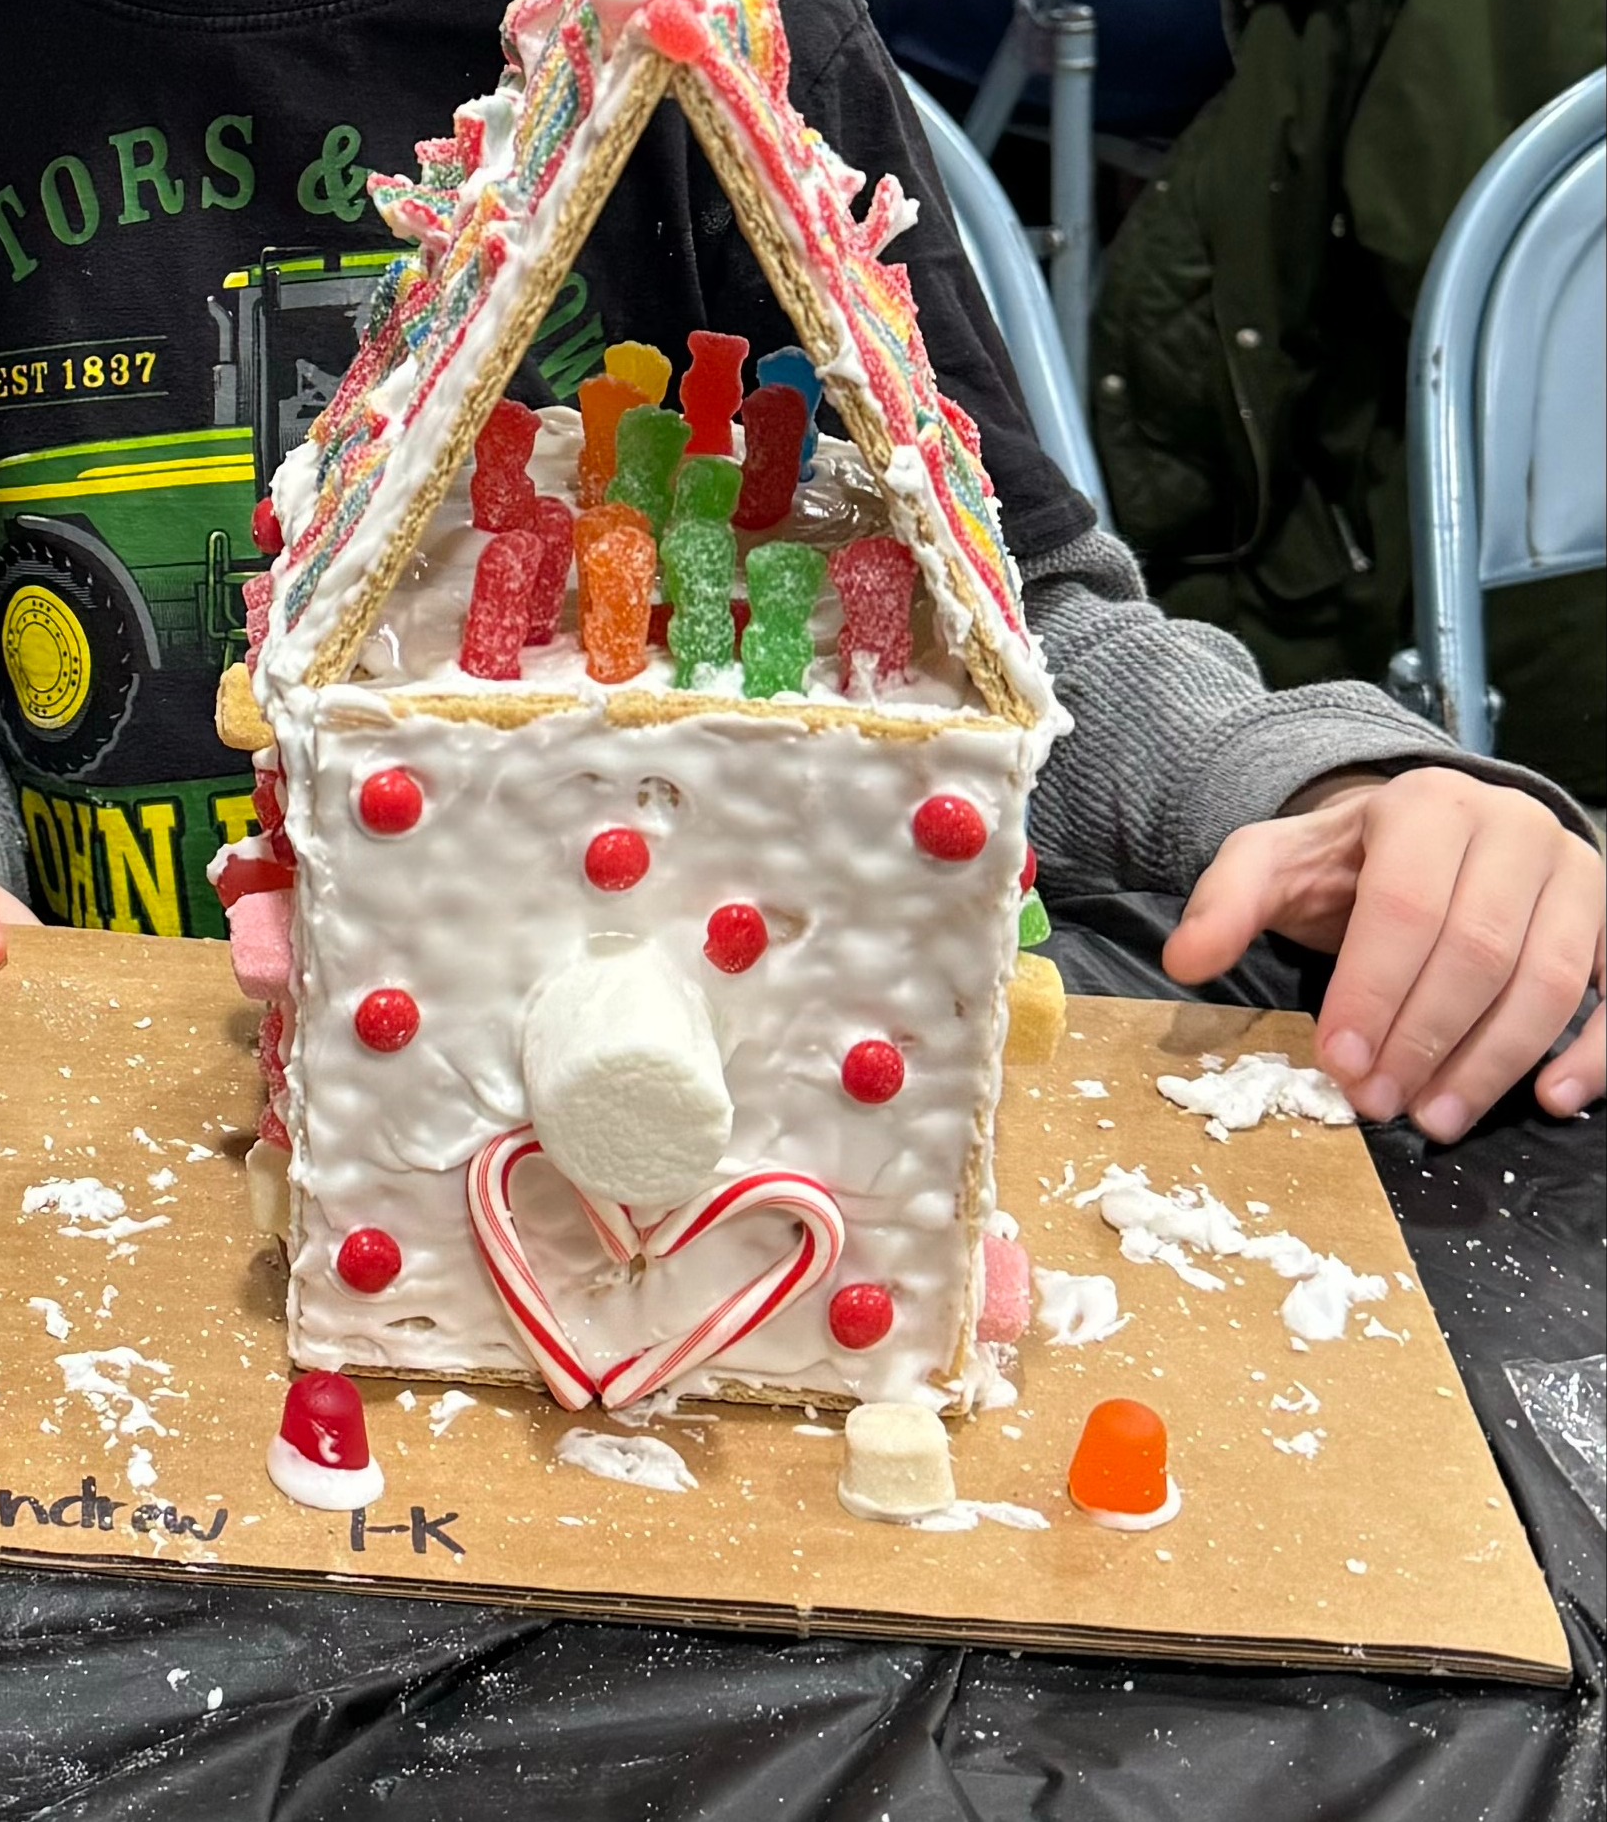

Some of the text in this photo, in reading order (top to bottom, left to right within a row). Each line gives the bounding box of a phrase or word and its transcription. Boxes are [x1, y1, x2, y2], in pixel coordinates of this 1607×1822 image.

[298, 125, 370, 222] &
[61, 351, 157, 391] 1837
[21, 786, 183, 937] OHN
